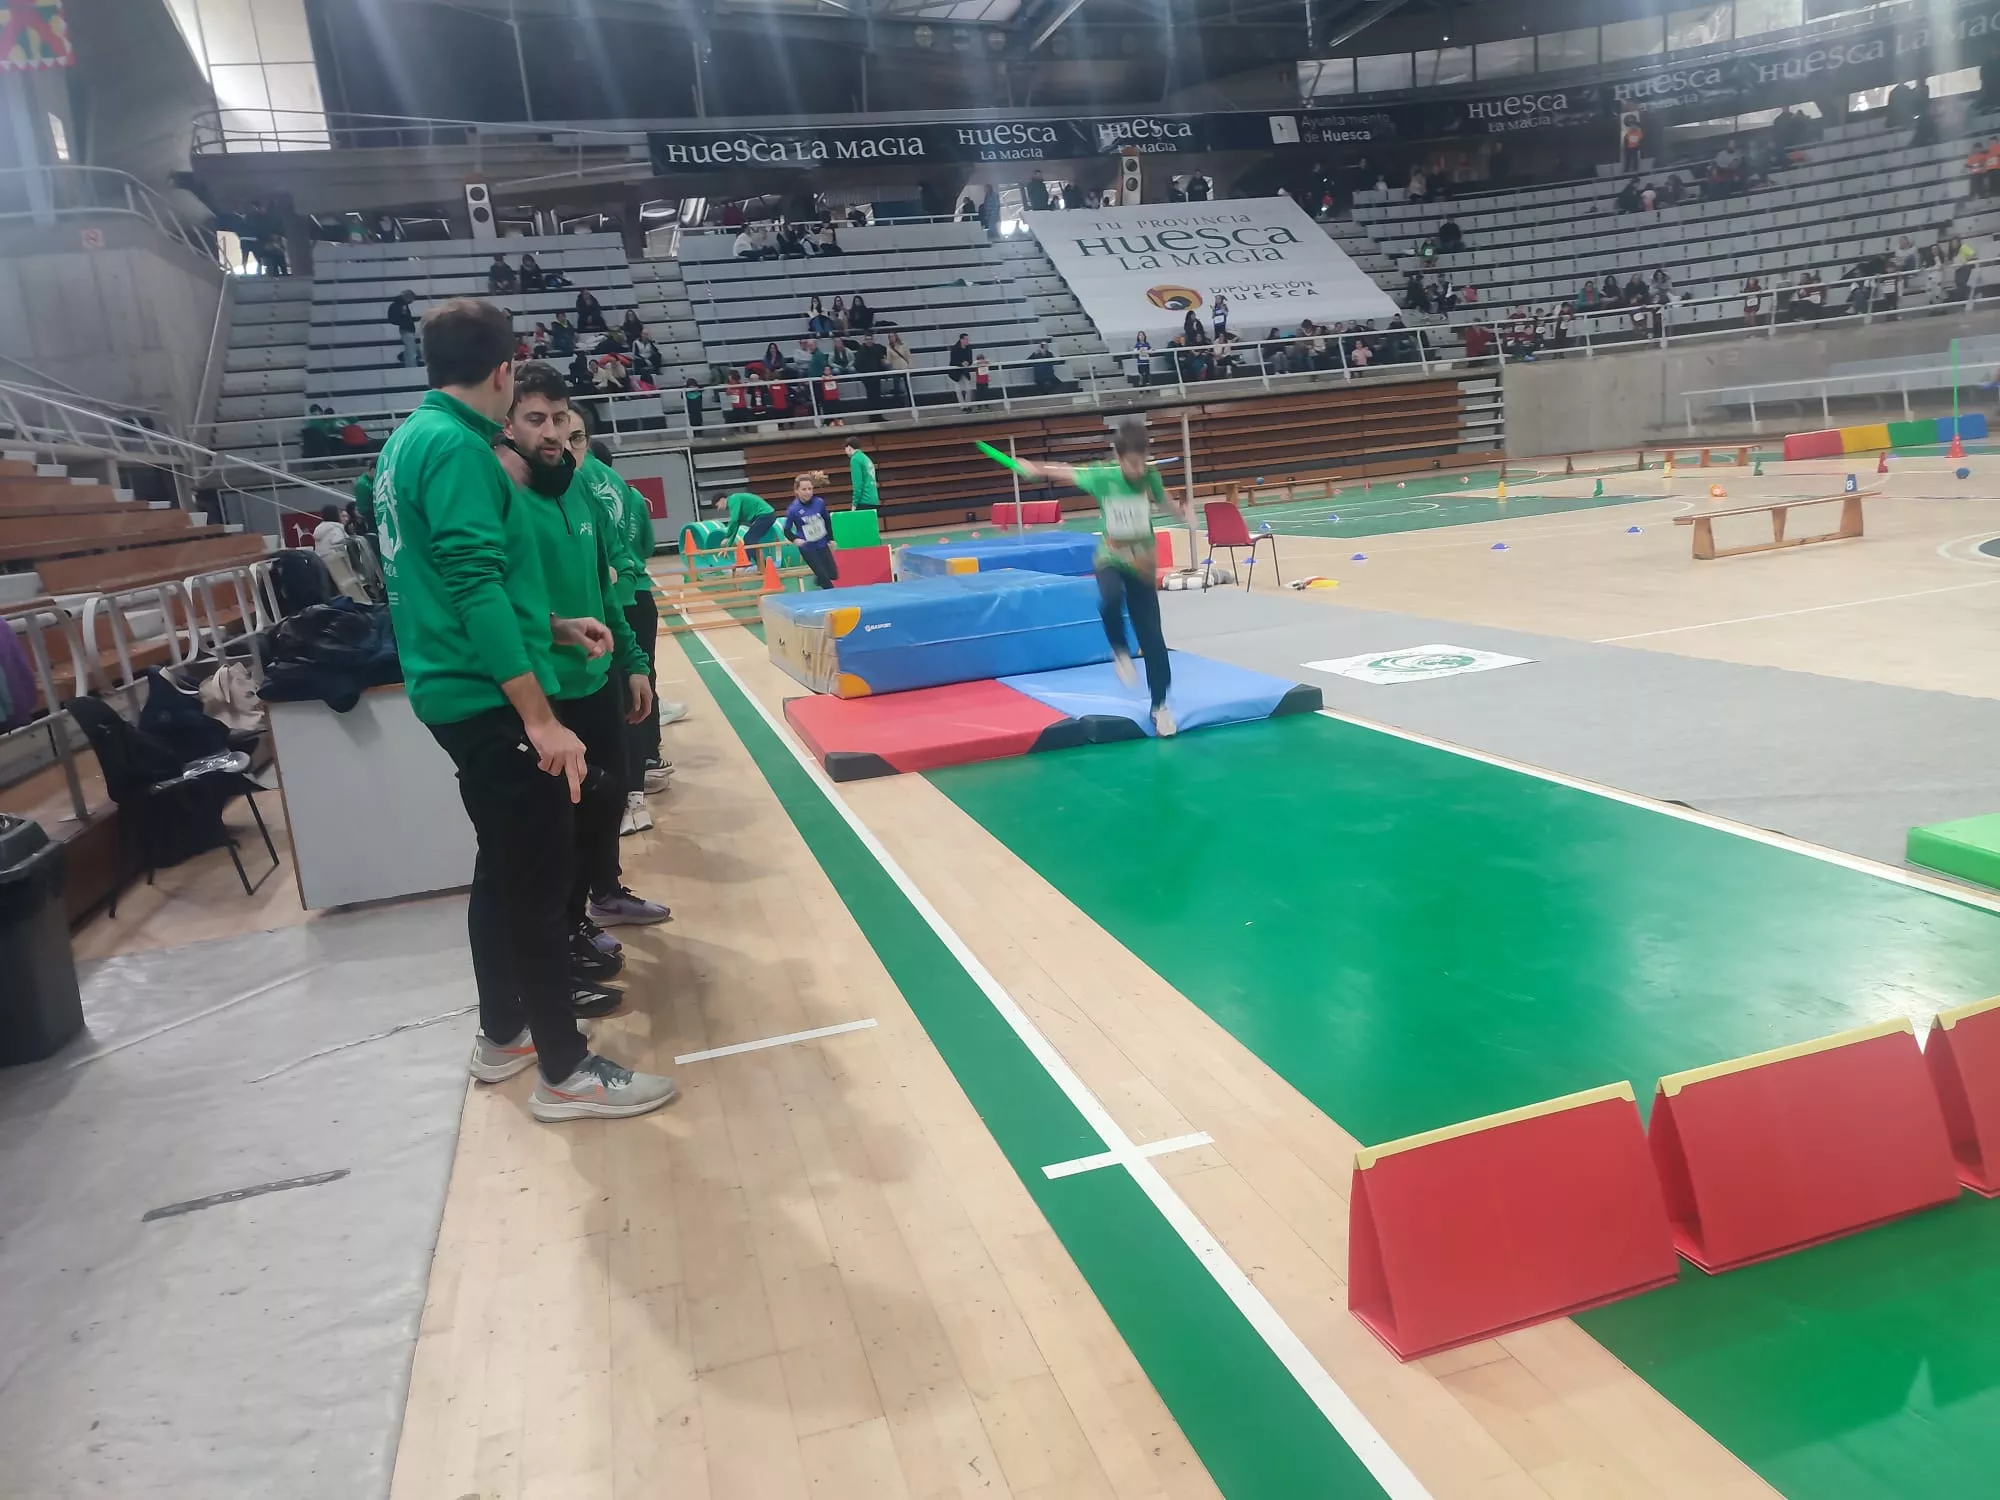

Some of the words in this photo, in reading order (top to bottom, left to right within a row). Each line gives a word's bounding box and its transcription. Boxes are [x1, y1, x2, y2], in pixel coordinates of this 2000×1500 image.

[1467, 93, 1569, 119] Huesca
[957, 124, 1058, 146] Huesca
[1096, 118, 1193, 140] Huesca
[1322, 129, 1372, 143] Huesca
[666, 139, 789, 164] Huesca
[1072, 226, 1304, 257] Huesca
[1846, 479, 1854, 491] 8
